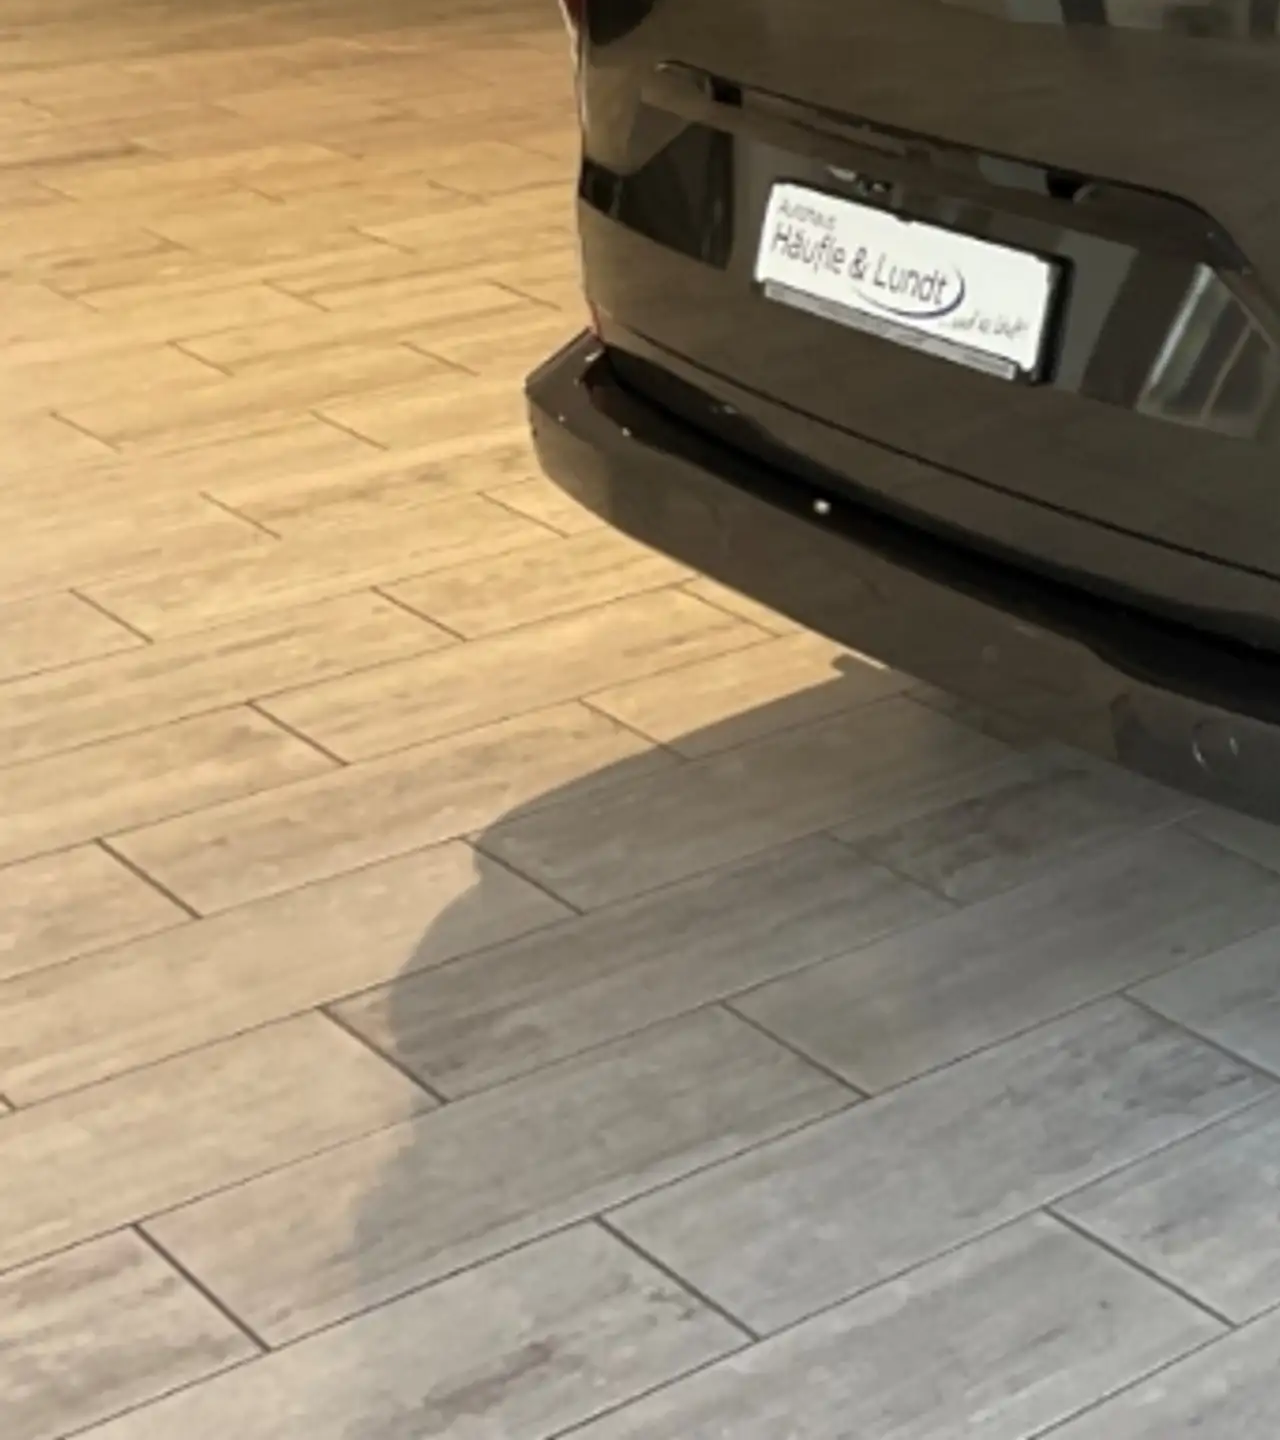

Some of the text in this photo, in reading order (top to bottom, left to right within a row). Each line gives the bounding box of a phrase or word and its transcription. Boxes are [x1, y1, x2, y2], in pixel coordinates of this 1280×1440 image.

[769, 221, 948, 306] Häufle & Lundt
